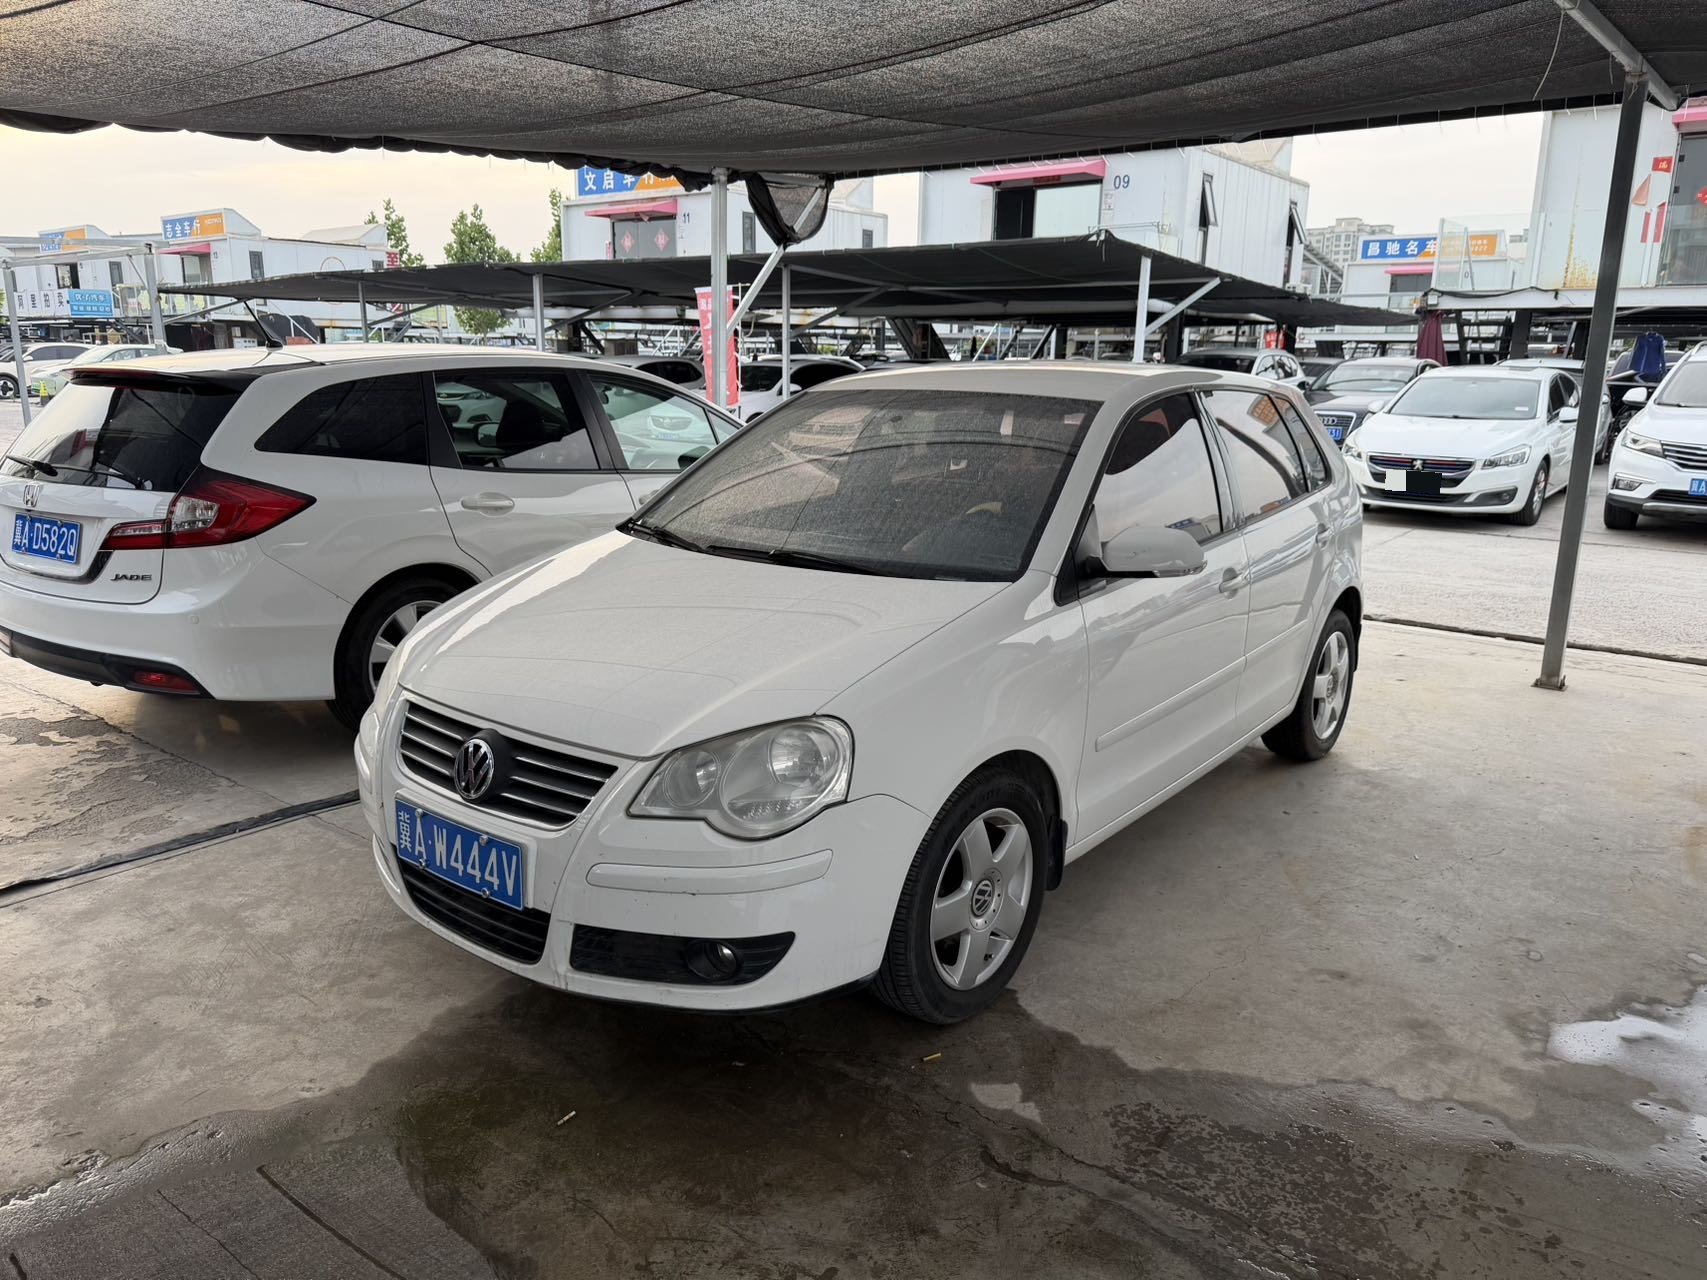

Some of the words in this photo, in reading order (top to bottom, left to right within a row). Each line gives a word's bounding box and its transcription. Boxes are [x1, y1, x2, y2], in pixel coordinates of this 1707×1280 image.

[1113, 174, 1130, 189] 09
[683, 212, 690, 224] 11
[1367, 240, 1438, 256] 昌驰名车
[110, 573, 153, 582] JADE
